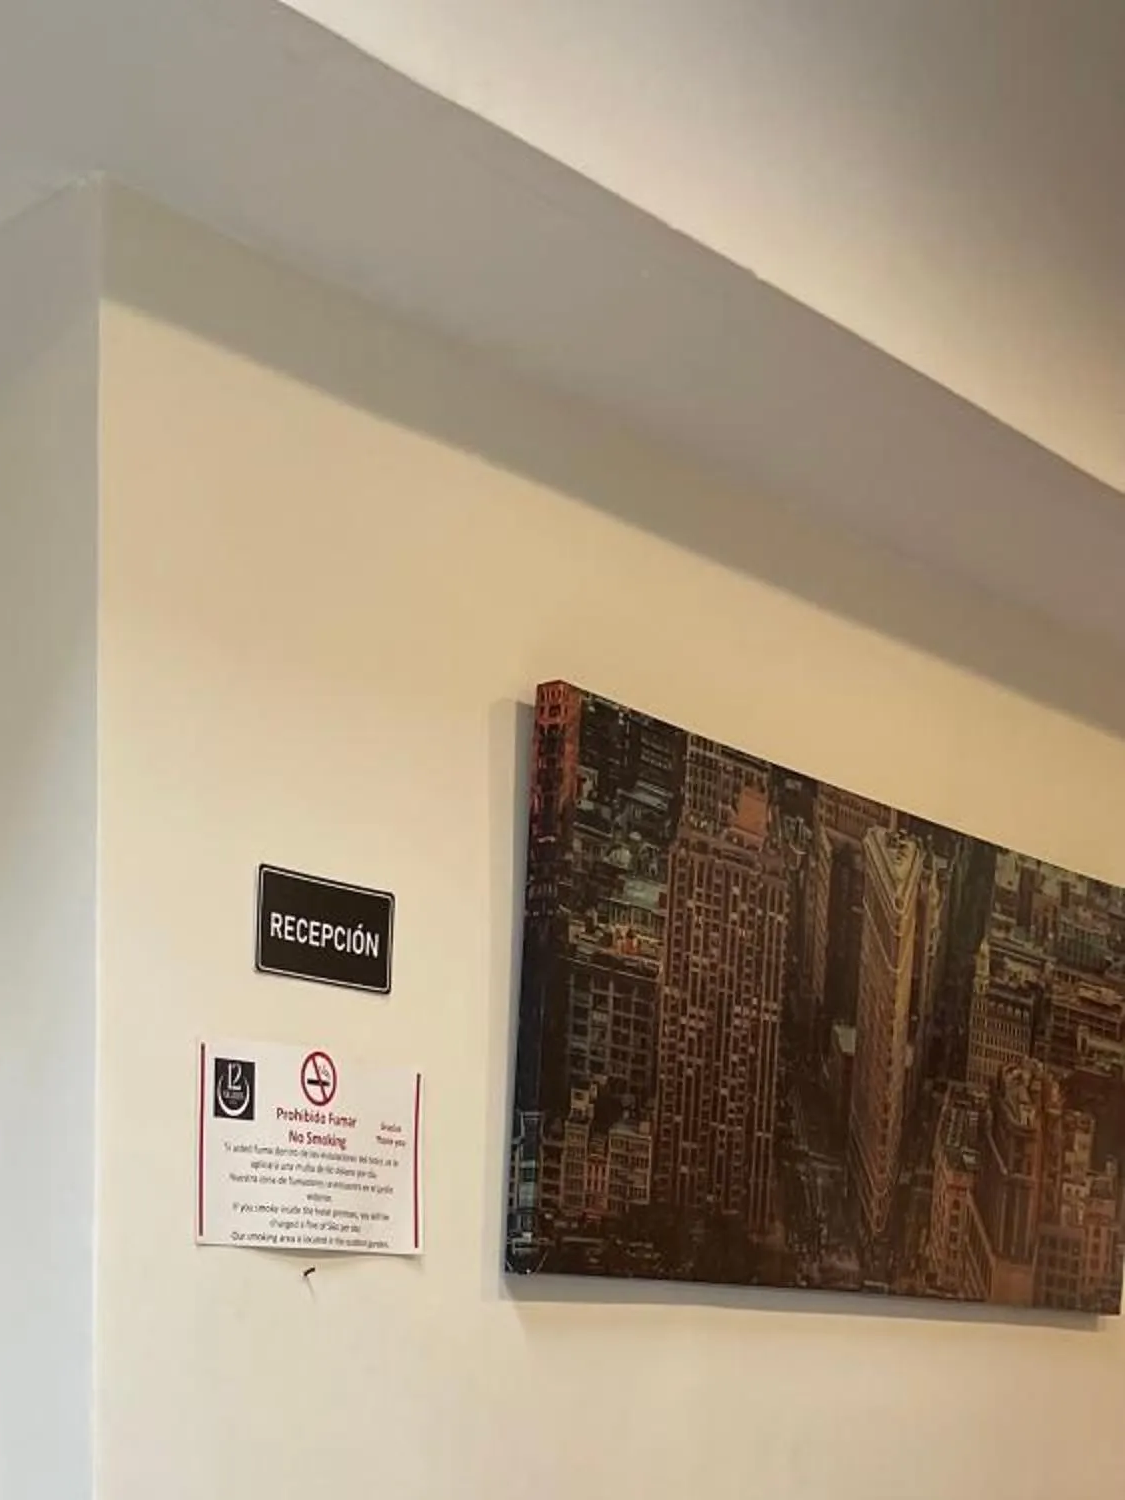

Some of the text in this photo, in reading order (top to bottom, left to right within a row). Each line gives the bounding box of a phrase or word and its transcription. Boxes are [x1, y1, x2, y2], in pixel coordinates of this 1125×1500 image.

[270, 912, 379, 958] RECEPCIÓN
[228, 1063, 242, 1090] 12
[276, 1107, 357, 1128] Prohibido Fumar
[288, 1130, 347, 1150] No Smoking
